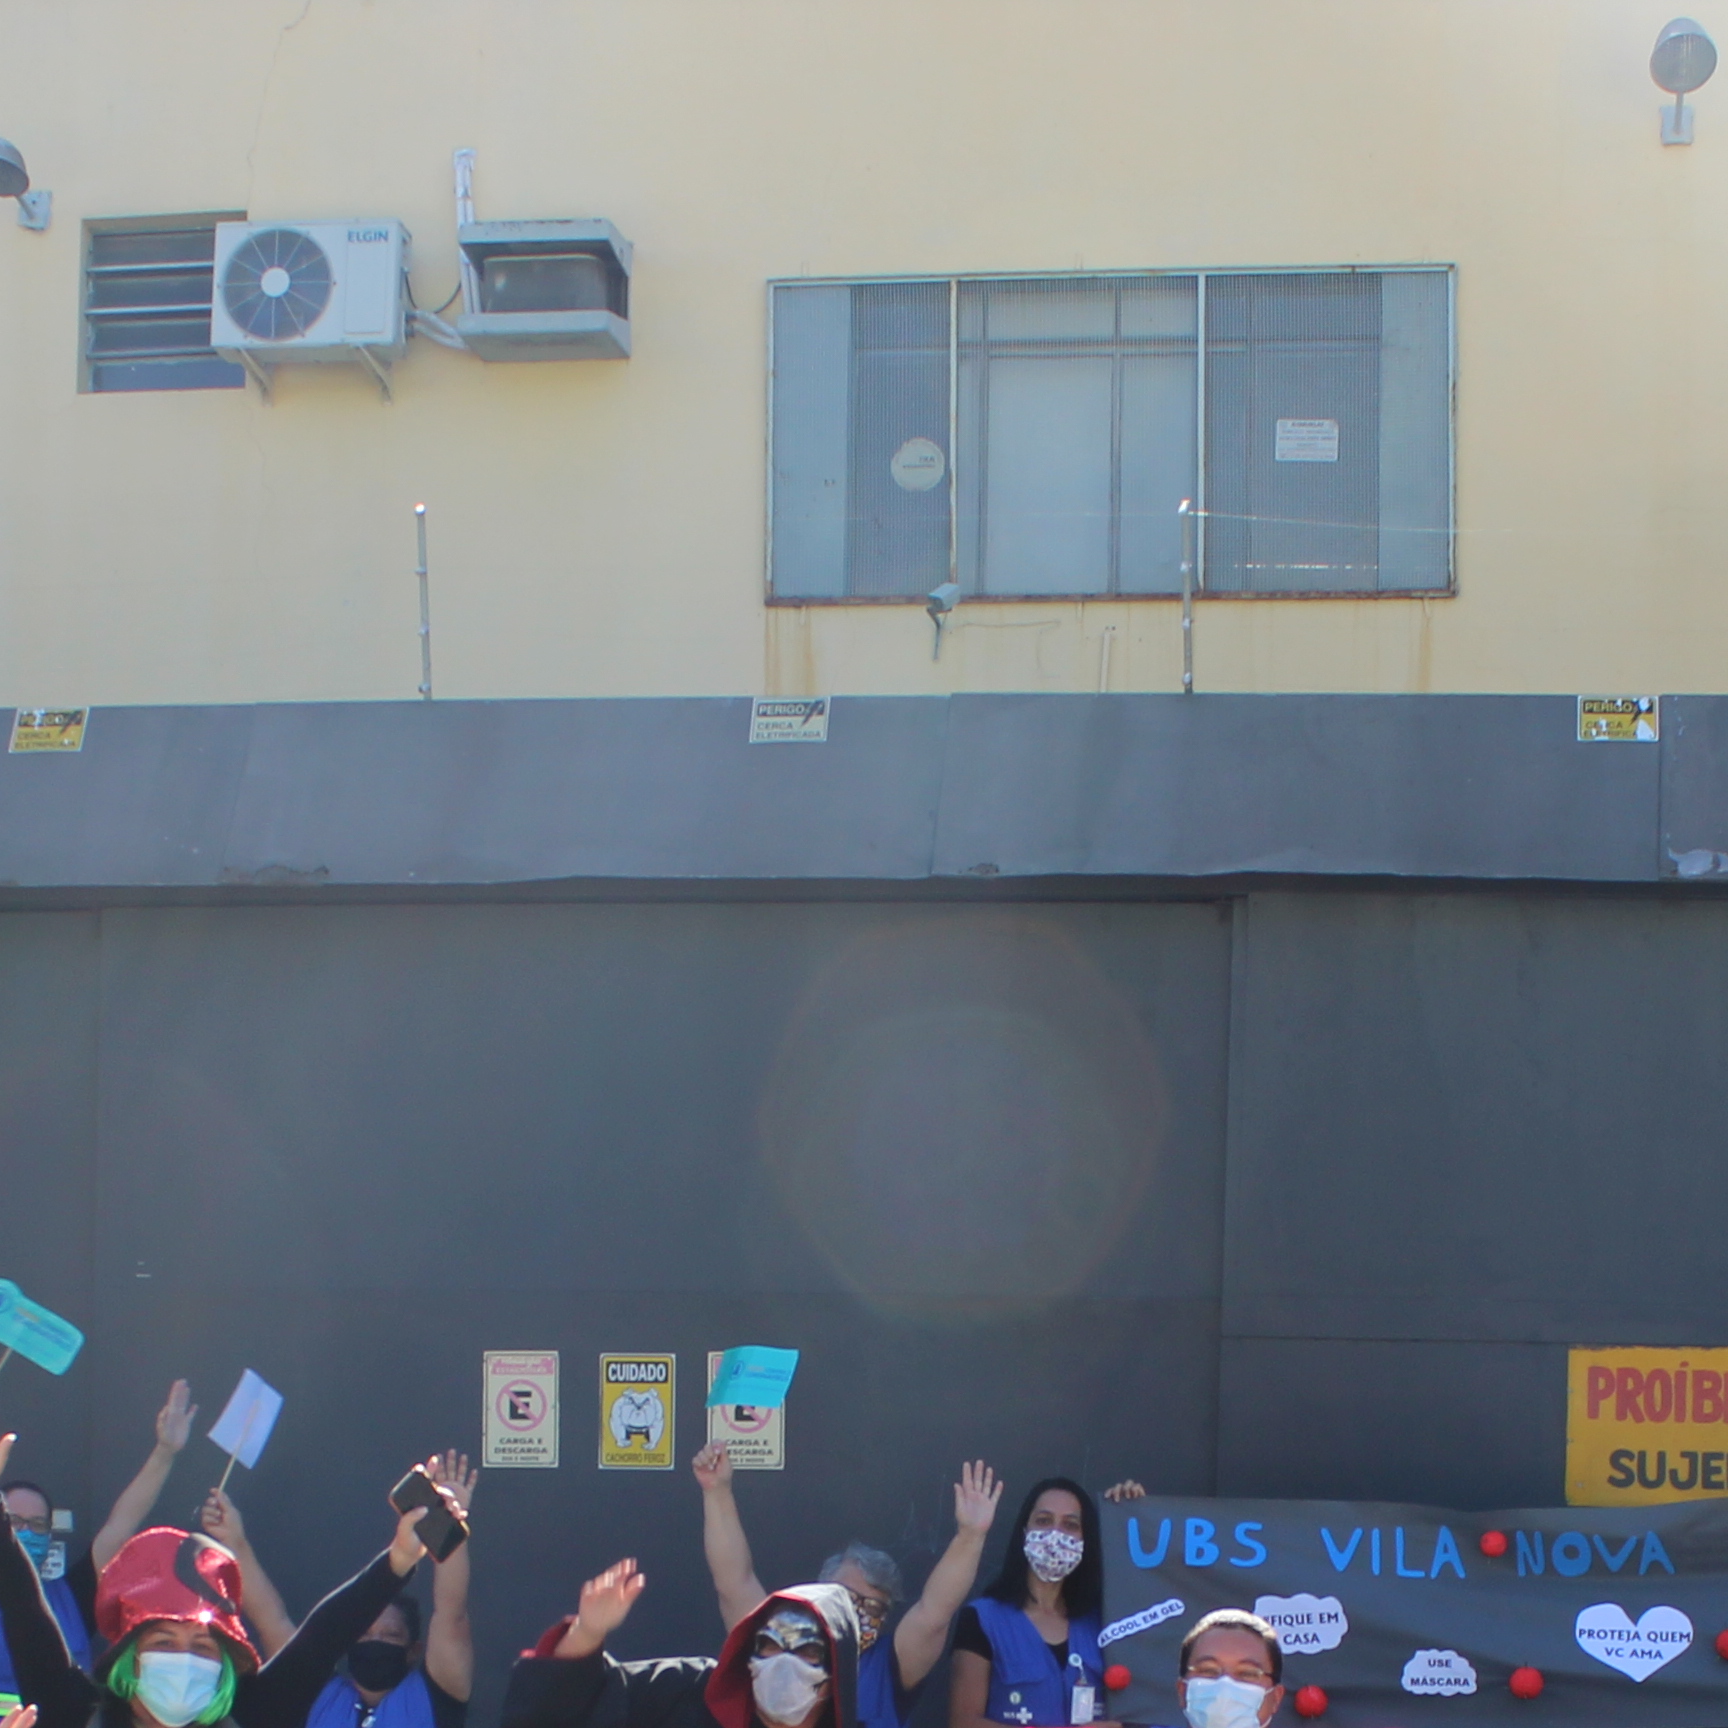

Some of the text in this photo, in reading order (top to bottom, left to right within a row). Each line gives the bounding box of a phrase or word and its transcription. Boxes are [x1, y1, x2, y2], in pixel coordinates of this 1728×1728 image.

[348, 230, 388, 242] ELGIN
[759, 704, 804, 715] PERIGO
[758, 722, 793, 730] CERCA
[608, 1363, 666, 1382] CUIDADO
[494, 1446, 548, 1454] DESCARGA
[727, 1448, 774, 1456] ESCARGA
[1127, 1517, 1268, 1569] UBS
[1321, 1526, 1466, 1579] VILA
[1514, 1530, 1674, 1578] NOVA
[1142, 1612, 1159, 1624] EM
[1160, 1602, 1183, 1616] GEL
[1319, 1612, 1339, 1624] EM
[1283, 1632, 1320, 1645] CASA
[1578, 1628, 1692, 1643] PROTEJA QUEM
[1604, 1648, 1664, 1660] VC AMA
[1428, 1659, 1452, 1668] USE
[1410, 1676, 1470, 1686] MÁSCARA
